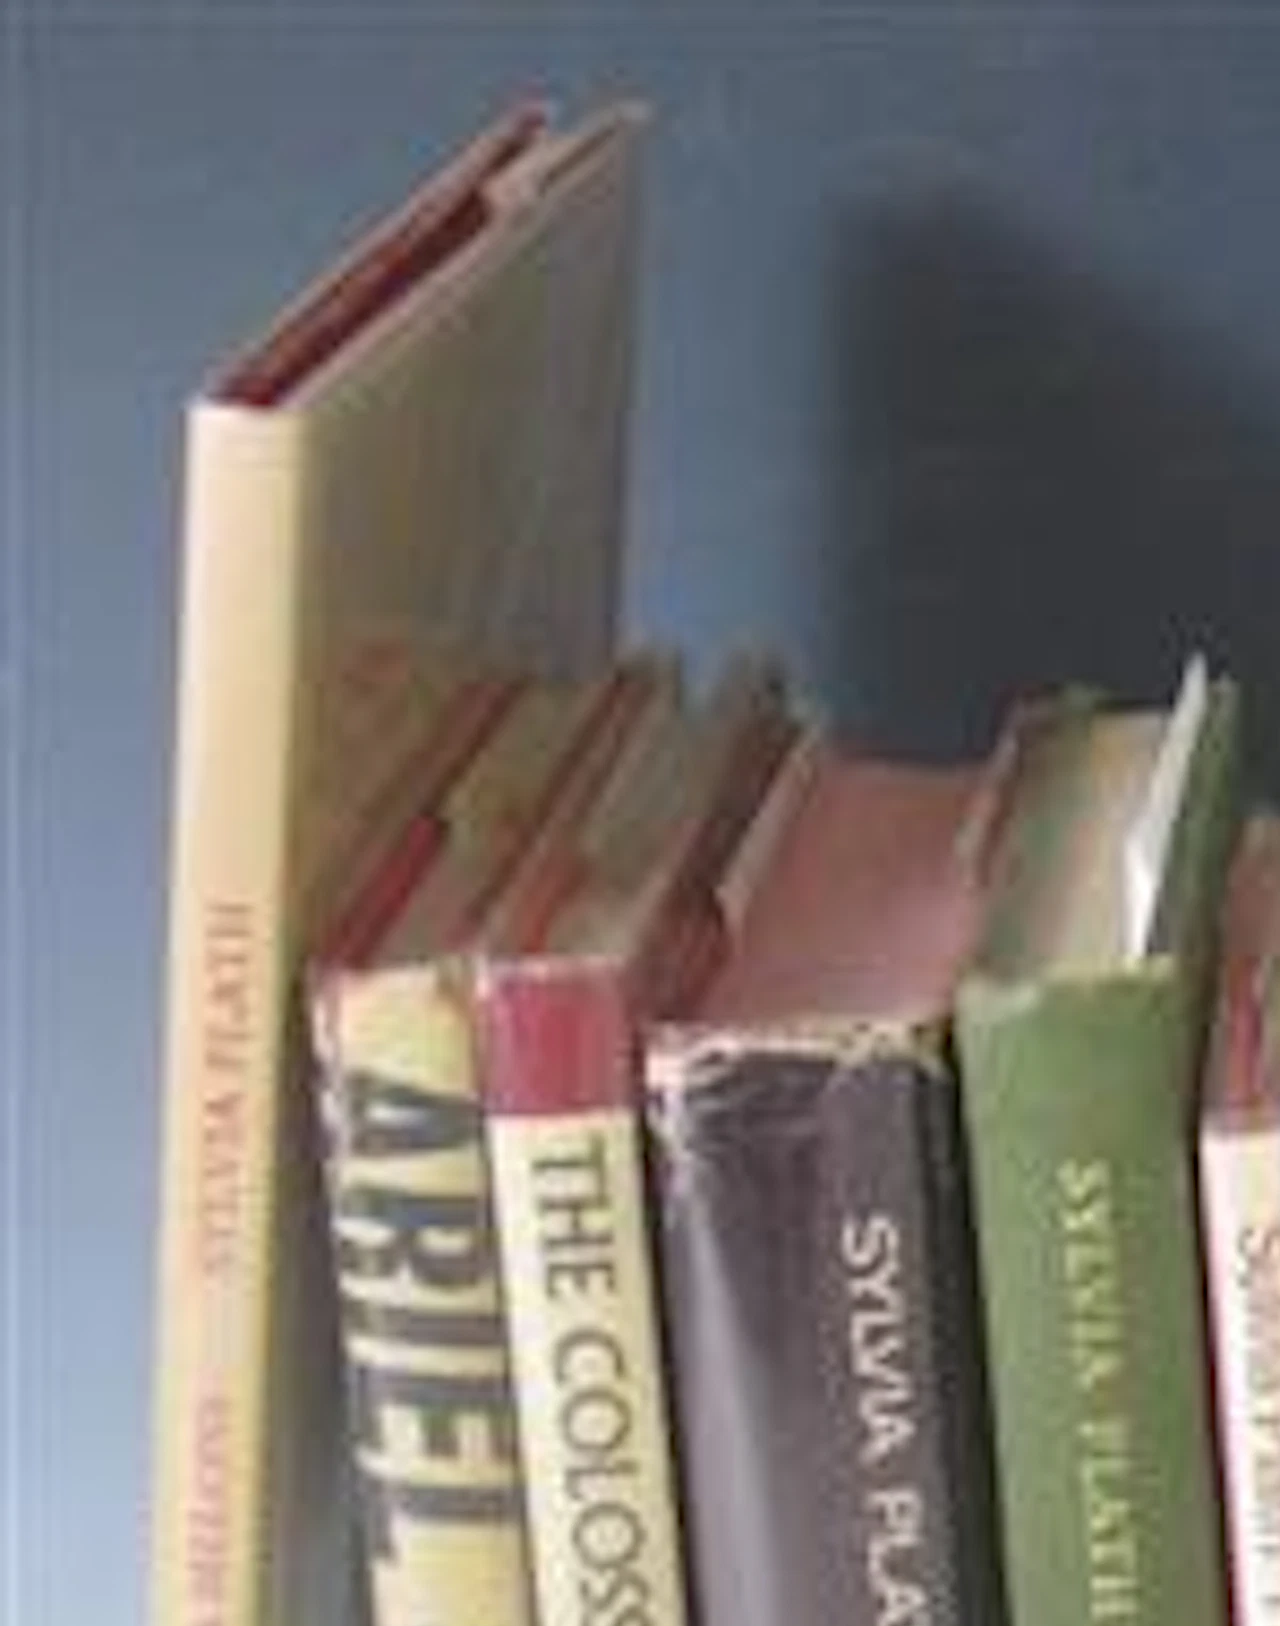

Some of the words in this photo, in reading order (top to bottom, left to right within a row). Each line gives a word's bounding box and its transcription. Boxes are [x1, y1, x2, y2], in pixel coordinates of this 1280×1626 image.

[343, 1068, 527, 1565] ARIEL
[533, 1130, 623, 1304] THE
[838, 1210, 920, 1462] SYLVIA
[1053, 1155, 1120, 1394] SYLVIA
